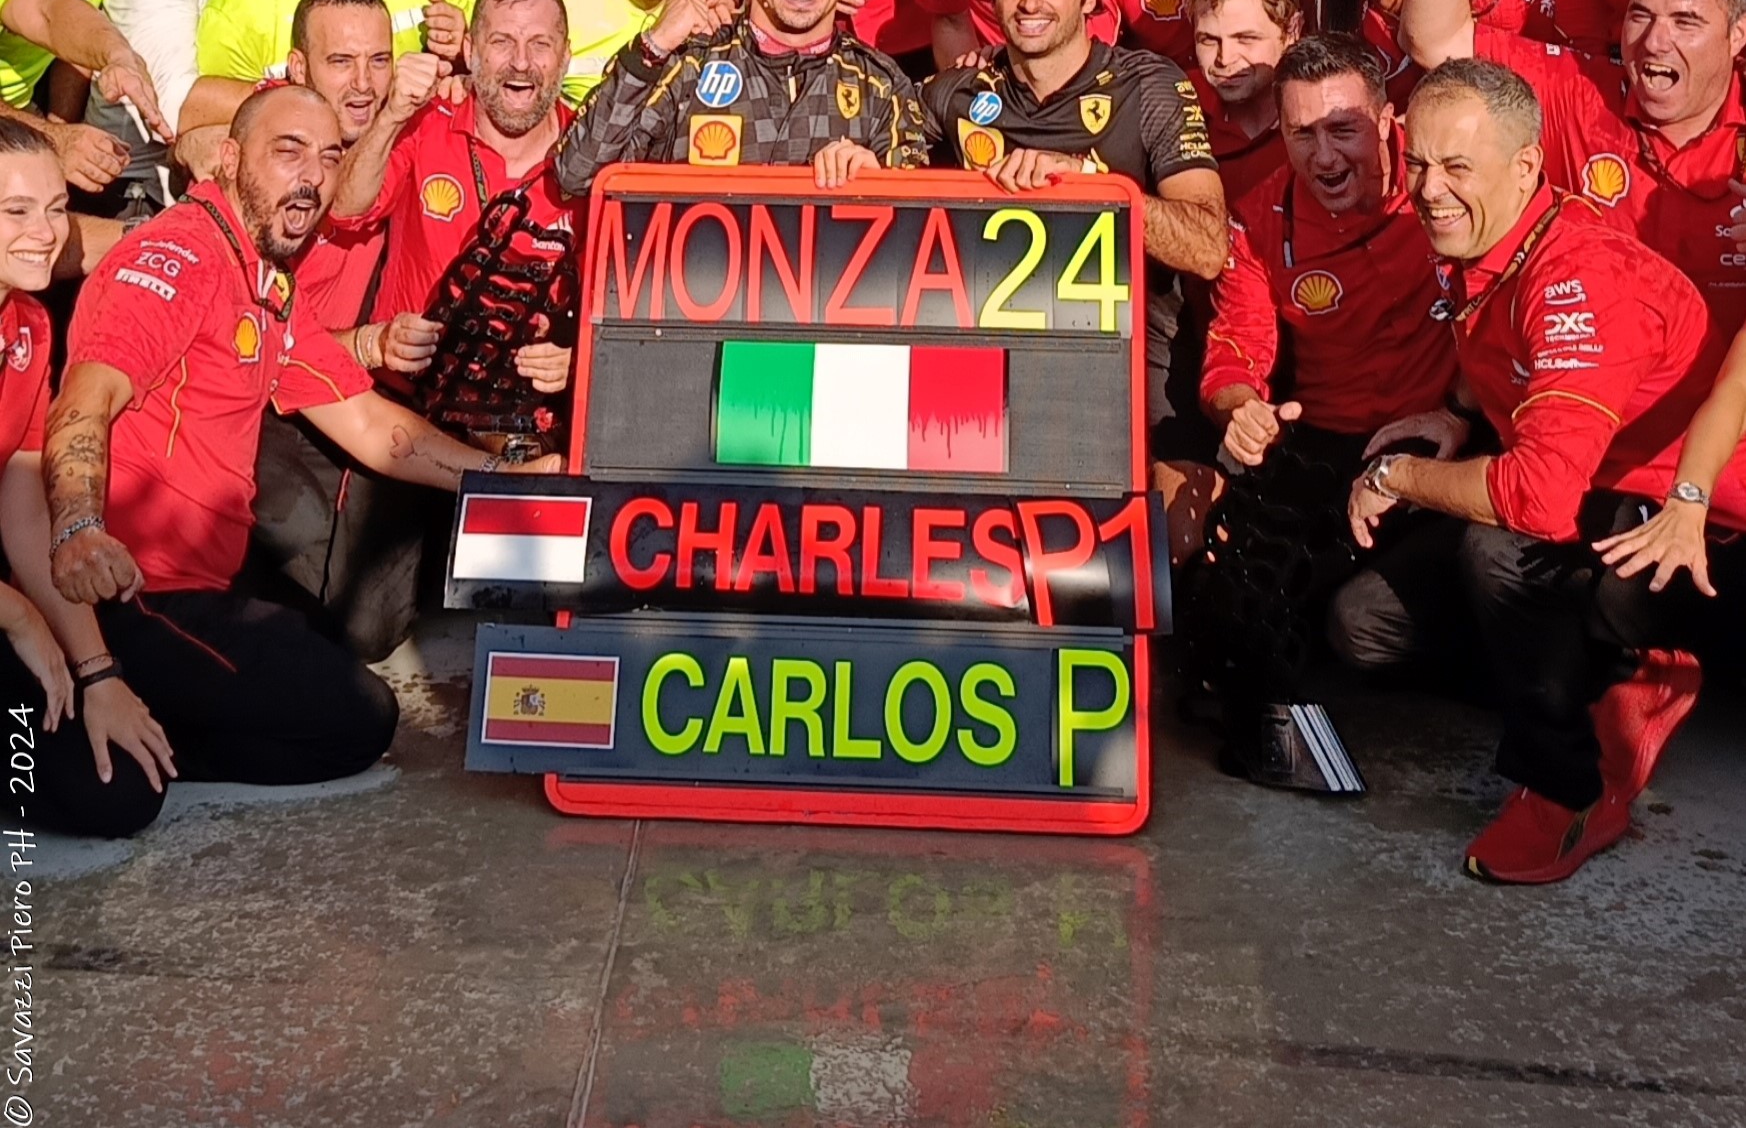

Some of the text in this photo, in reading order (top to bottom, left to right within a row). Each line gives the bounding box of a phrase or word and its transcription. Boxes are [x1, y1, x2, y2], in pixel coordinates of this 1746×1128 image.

[700, 61, 737, 106] hp
[972, 93, 999, 124] hp
[134, 251, 181, 278] ZCG
[592, 200, 1129, 332] MONZA 24
[1544, 279, 1583, 299] aws
[1543, 312, 1595, 336] DXC
[609, 496, 1153, 630] CHARLES P1
[641, 648, 1130, 787] CARLOS P
